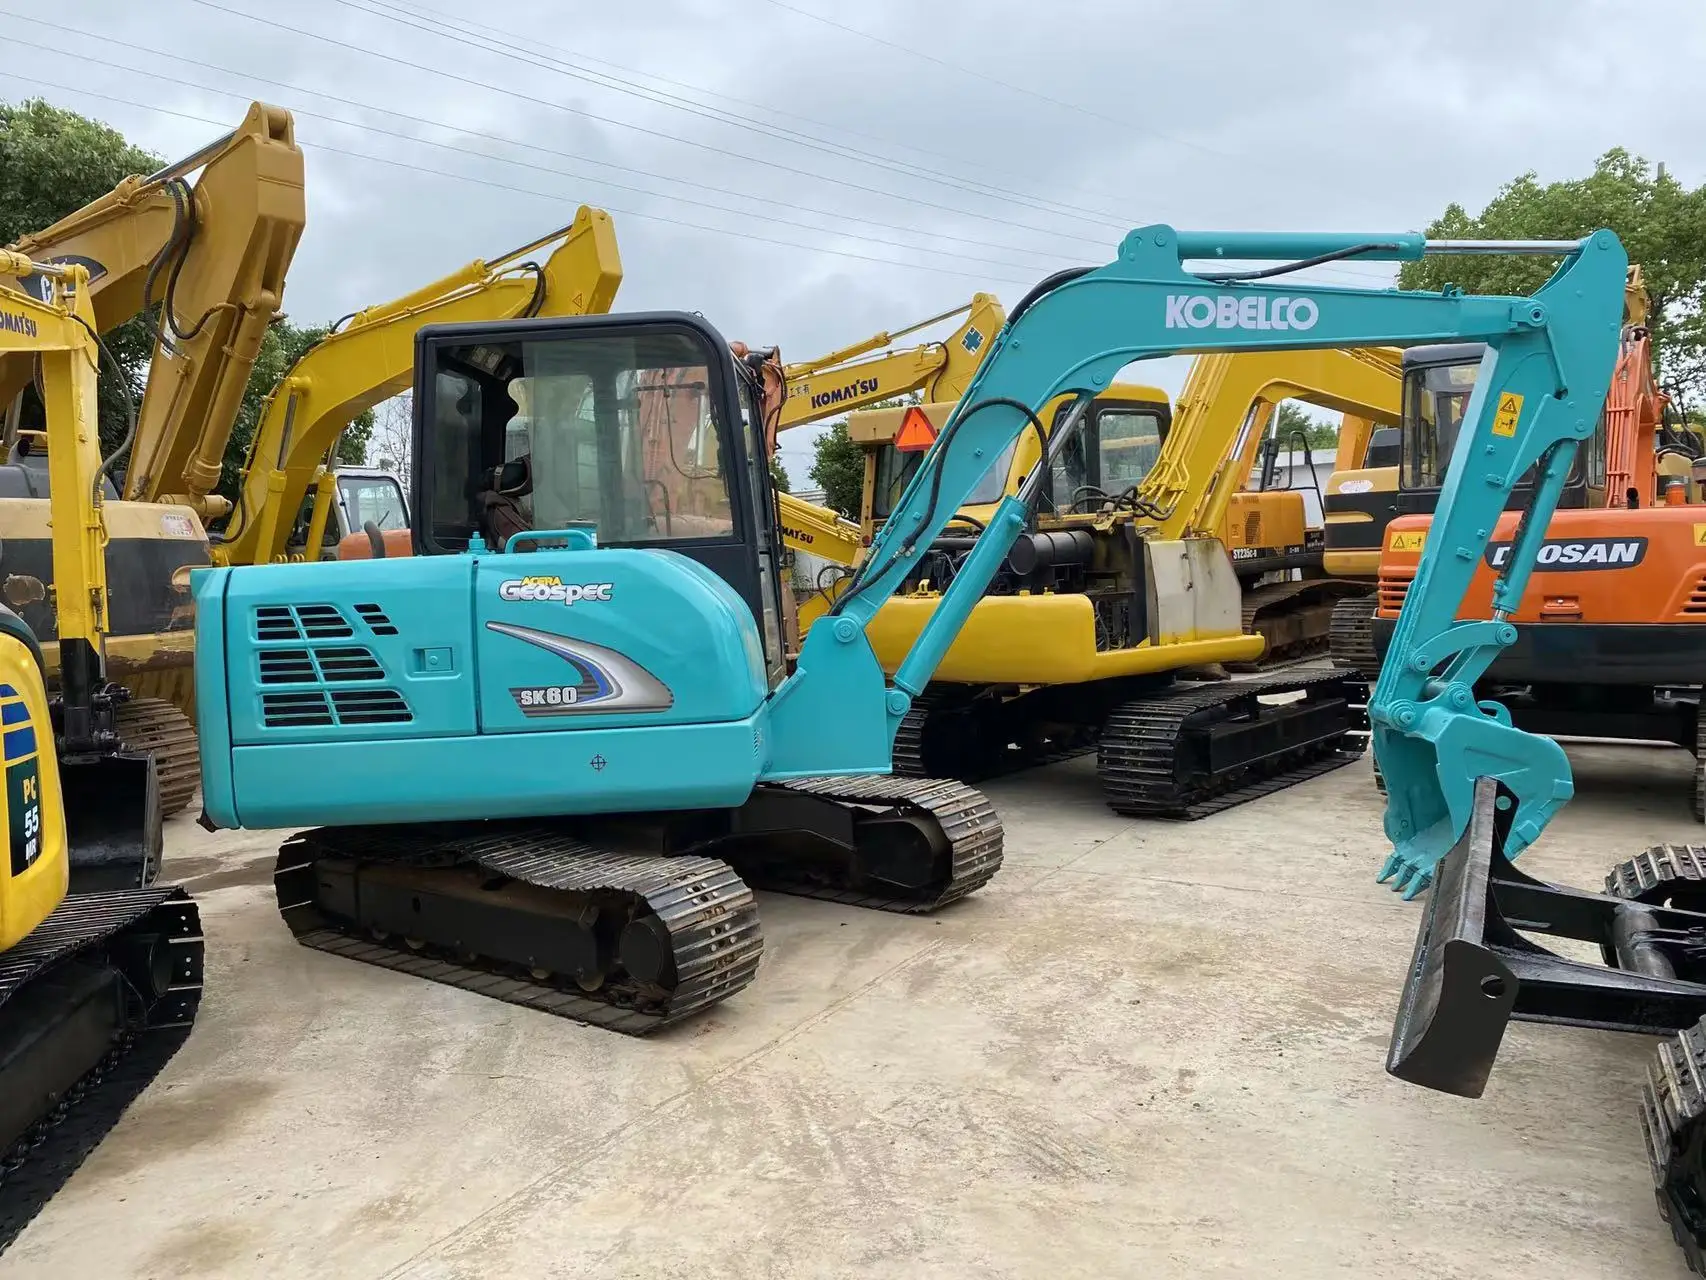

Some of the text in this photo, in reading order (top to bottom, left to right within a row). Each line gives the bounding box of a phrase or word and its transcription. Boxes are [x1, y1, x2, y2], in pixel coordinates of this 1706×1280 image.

[0, 310, 37, 338] OMATSU
[1165, 295, 1319, 331] KOBELCO
[811, 377, 879, 409] KOMATSU
[1491, 542, 1640, 566] DOSAN
[521, 576, 562, 586] ACERA
[520, 686, 577, 705] SK60
[23, 775, 37, 804] PC
[24, 805, 39, 838] 55
[25, 838, 37, 861] MR
